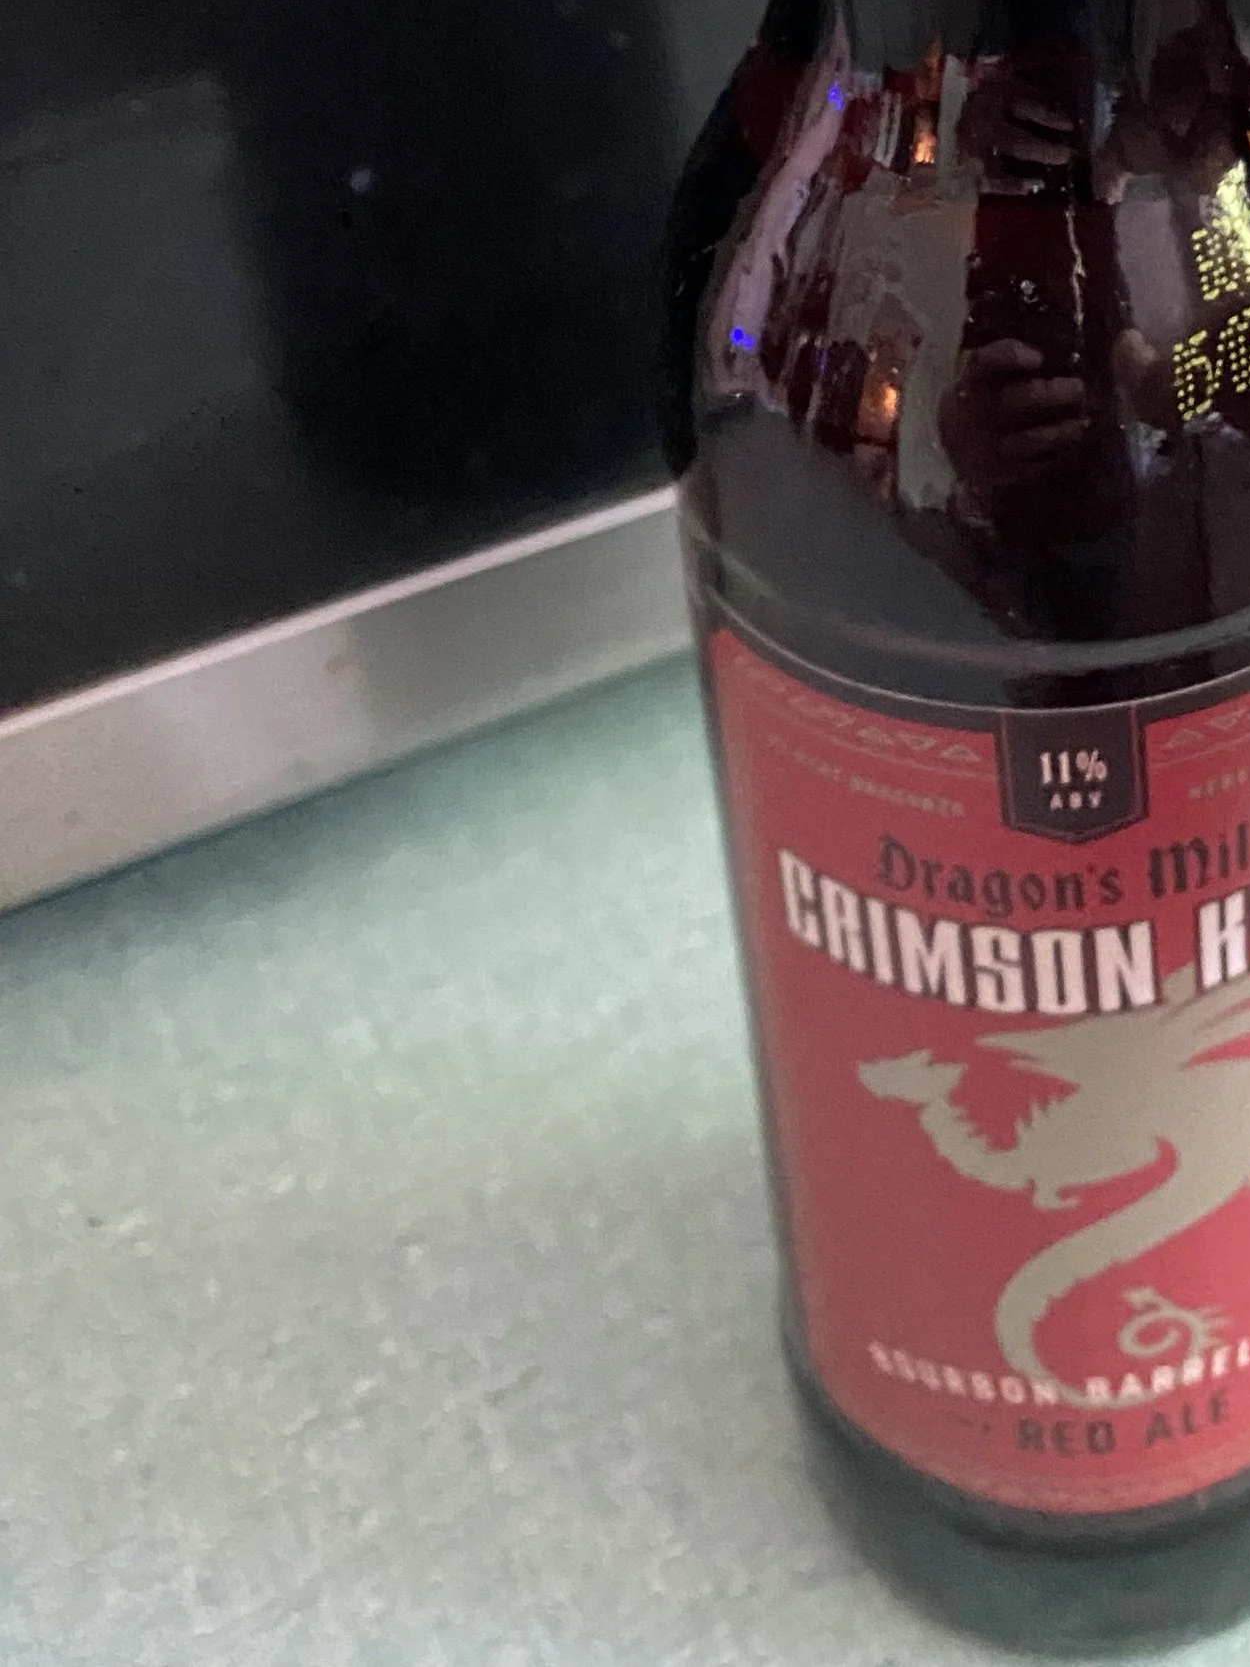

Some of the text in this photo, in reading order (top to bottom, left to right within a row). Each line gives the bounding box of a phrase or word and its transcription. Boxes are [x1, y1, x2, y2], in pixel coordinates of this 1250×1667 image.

[1039, 749, 1108, 784] 11%
[876, 835, 1121, 916] Dragon's
[778, 848, 1158, 1013] CRIMSON
